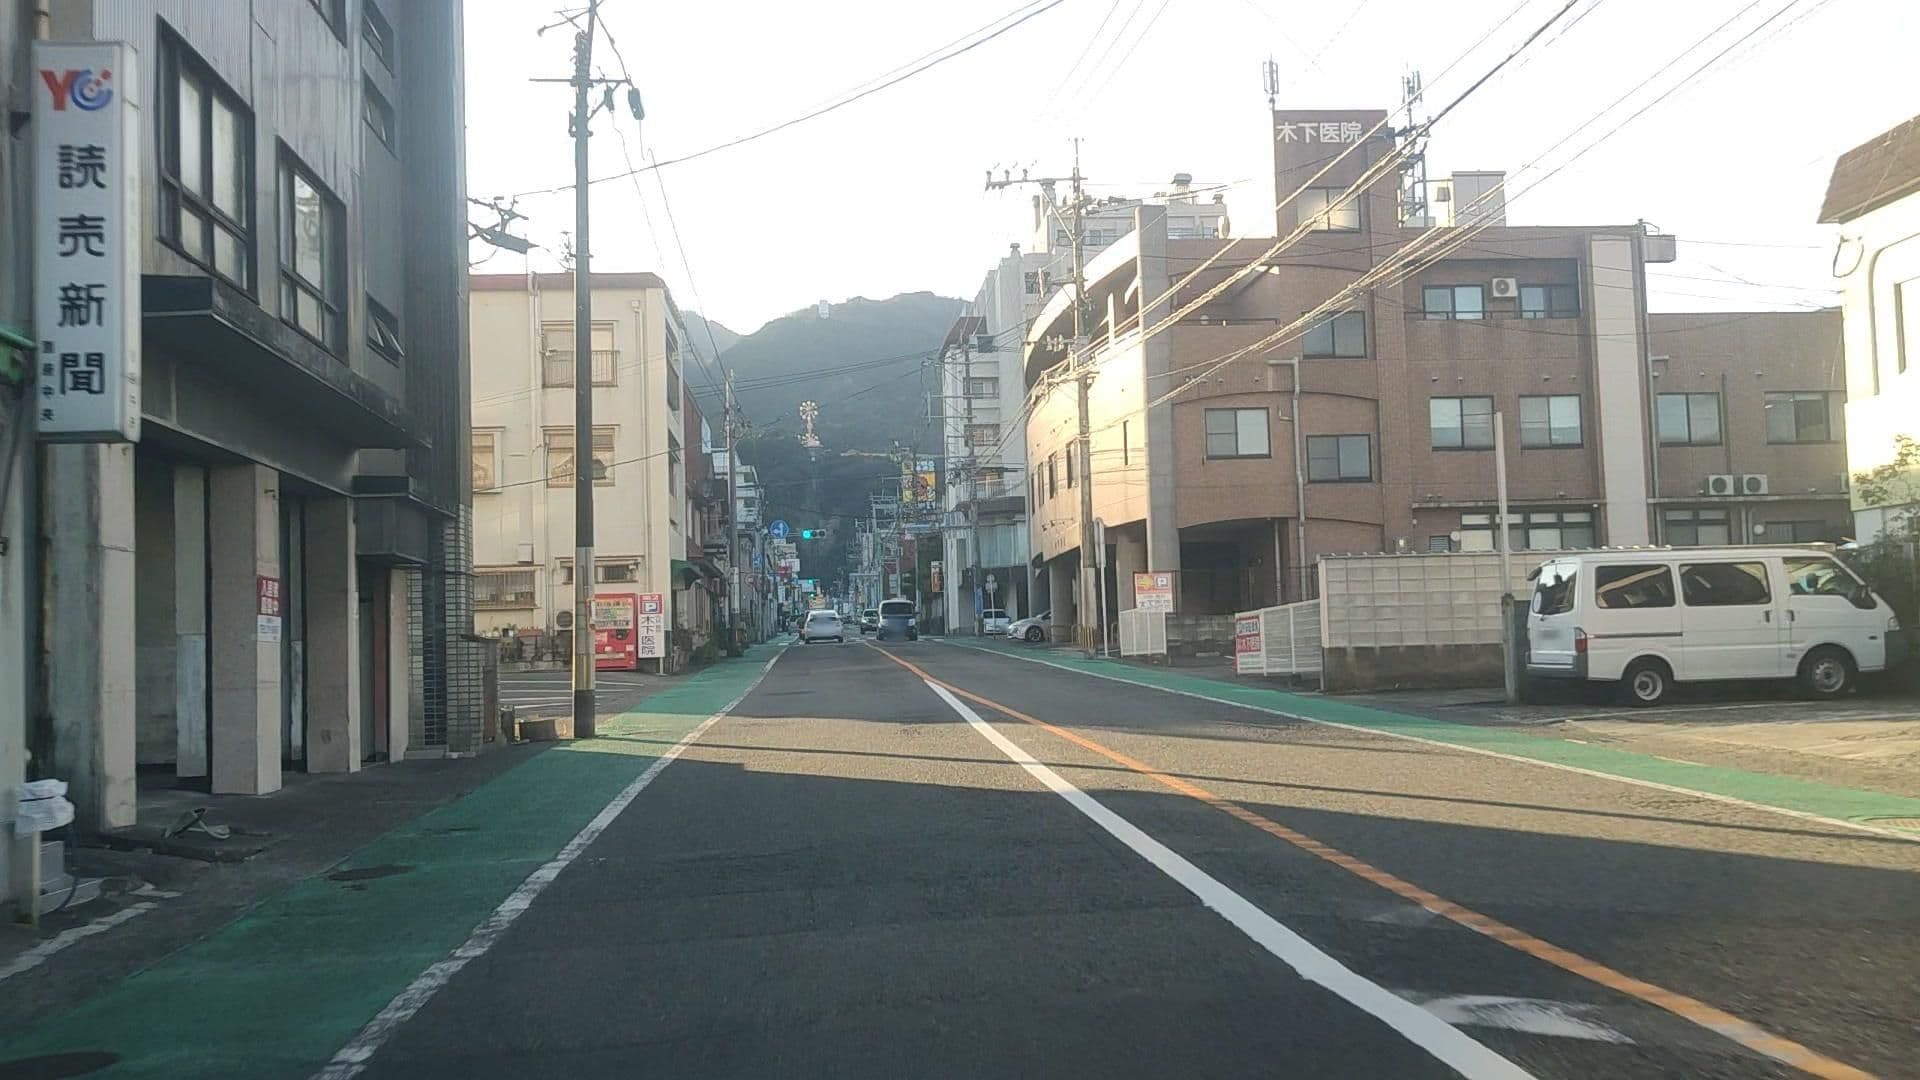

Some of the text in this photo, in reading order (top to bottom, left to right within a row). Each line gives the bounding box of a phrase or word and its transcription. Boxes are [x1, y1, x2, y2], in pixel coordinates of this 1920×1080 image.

[1275, 122, 1363, 144] 木下医院
[57, 144, 107, 395] 読売新聞
[640, 616, 656, 656] 木下医院
